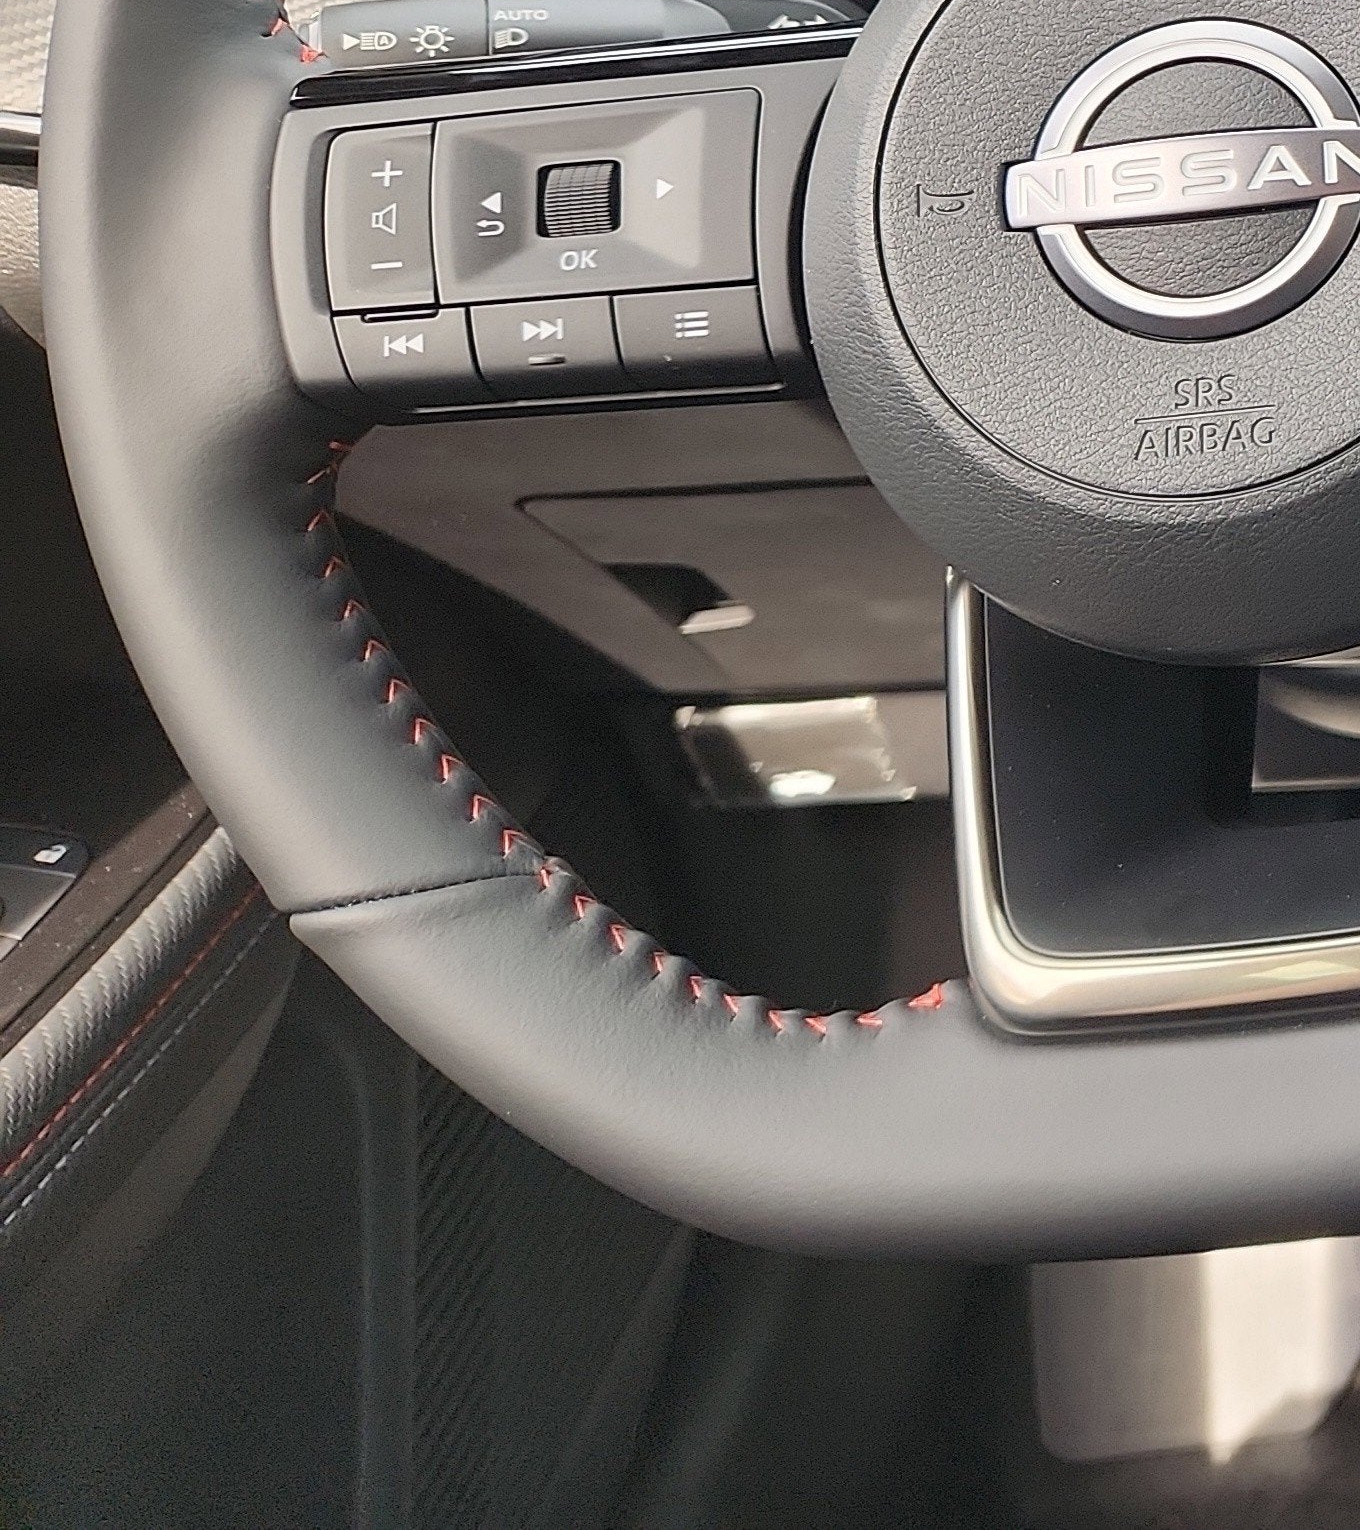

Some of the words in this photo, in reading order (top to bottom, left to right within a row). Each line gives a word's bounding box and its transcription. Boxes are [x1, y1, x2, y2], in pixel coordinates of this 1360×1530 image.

[494, 9, 548, 21] AUTO
[559, 249, 599, 271] OK
[1174, 375, 1237, 410] SRS
[1133, 417, 1277, 461] AIRBAG
